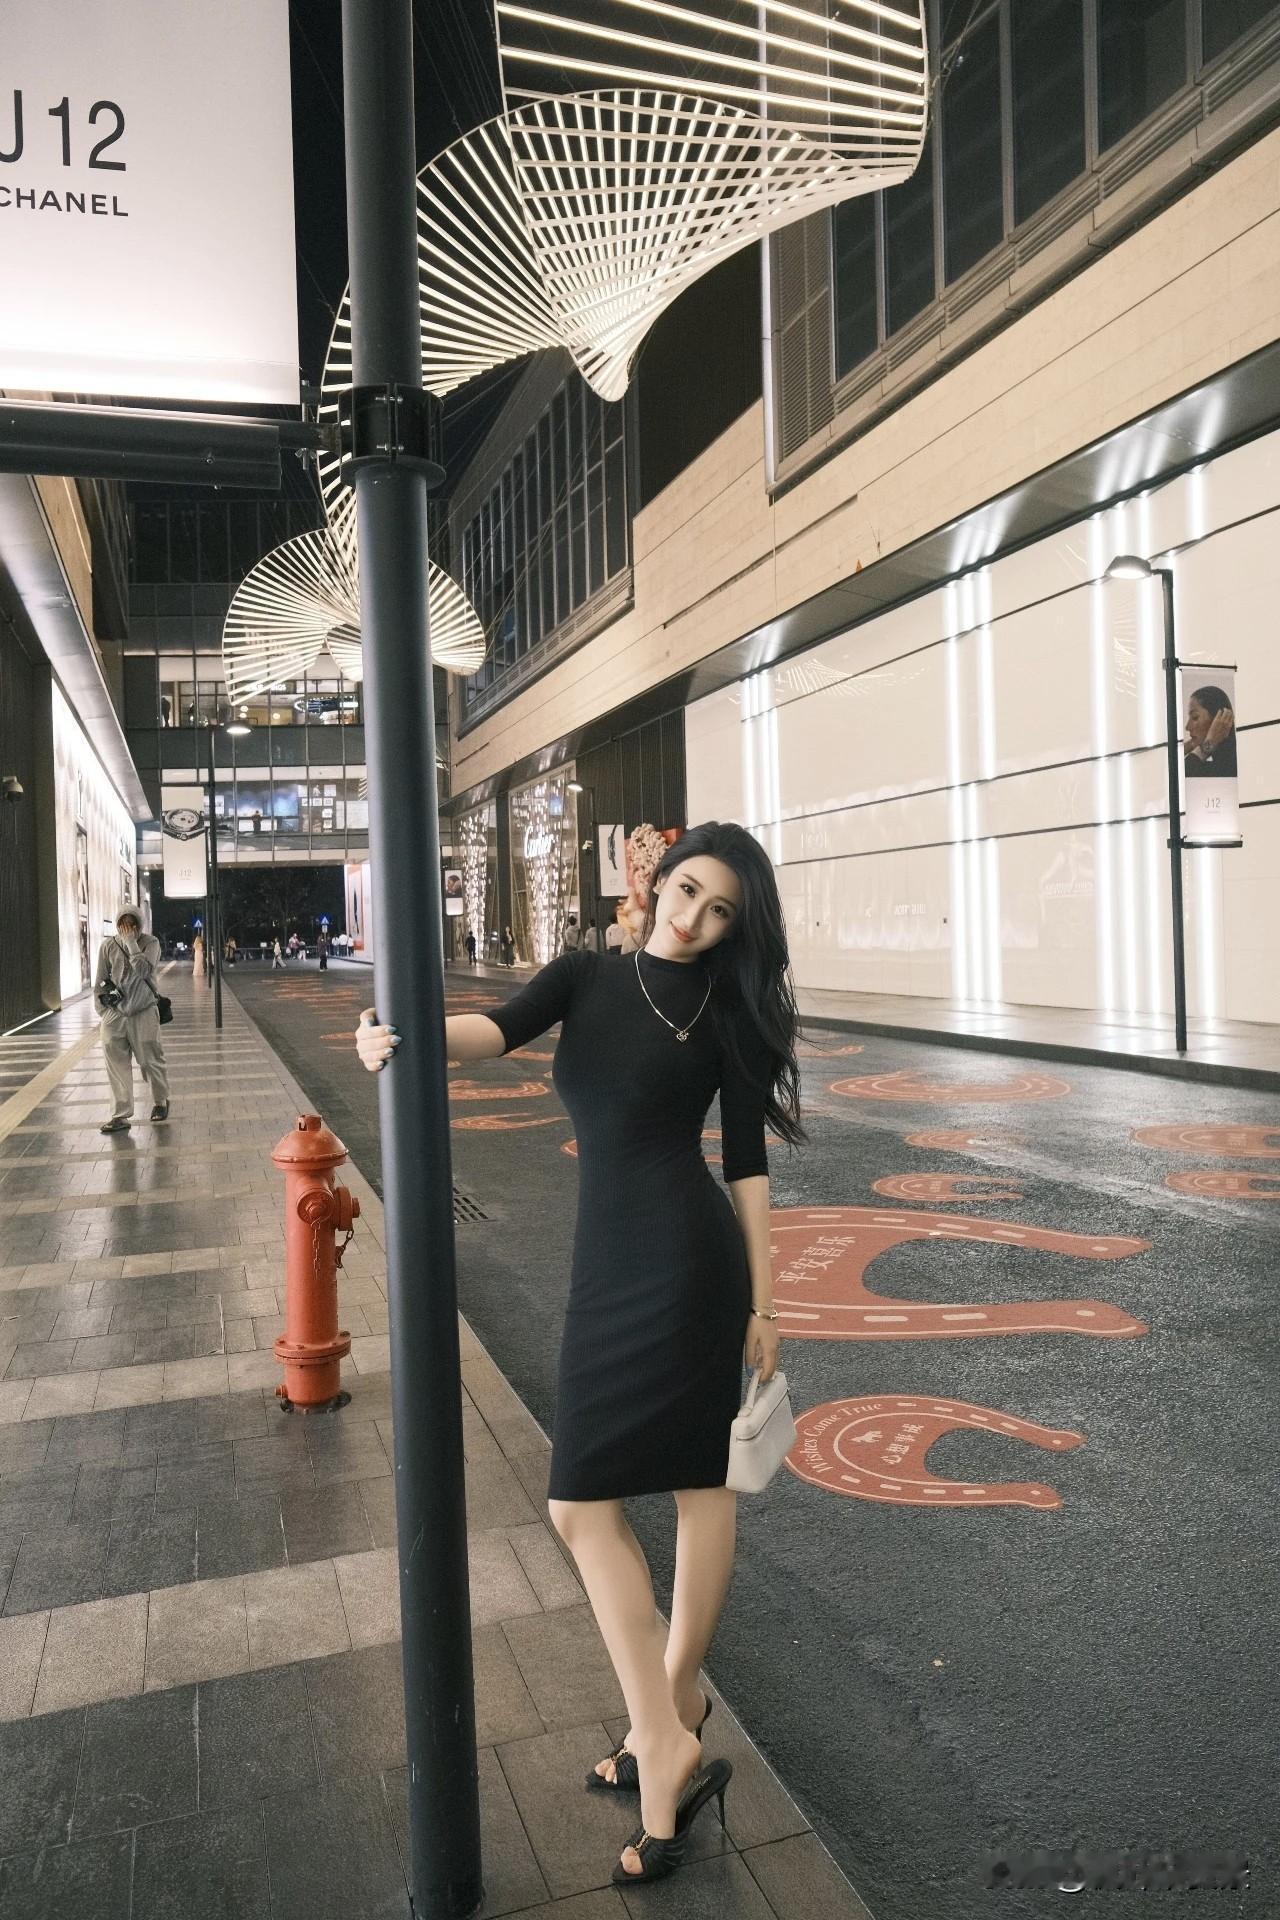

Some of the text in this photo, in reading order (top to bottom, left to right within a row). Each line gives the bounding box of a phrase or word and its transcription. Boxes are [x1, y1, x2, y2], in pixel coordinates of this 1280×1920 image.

[1204, 797, 1221, 809] J12
[775, 1236, 857, 1285] 平安喜乐
[799, 1402, 882, 1473] Wishes Come True
[880, 1422, 925, 1465] 心想事成
